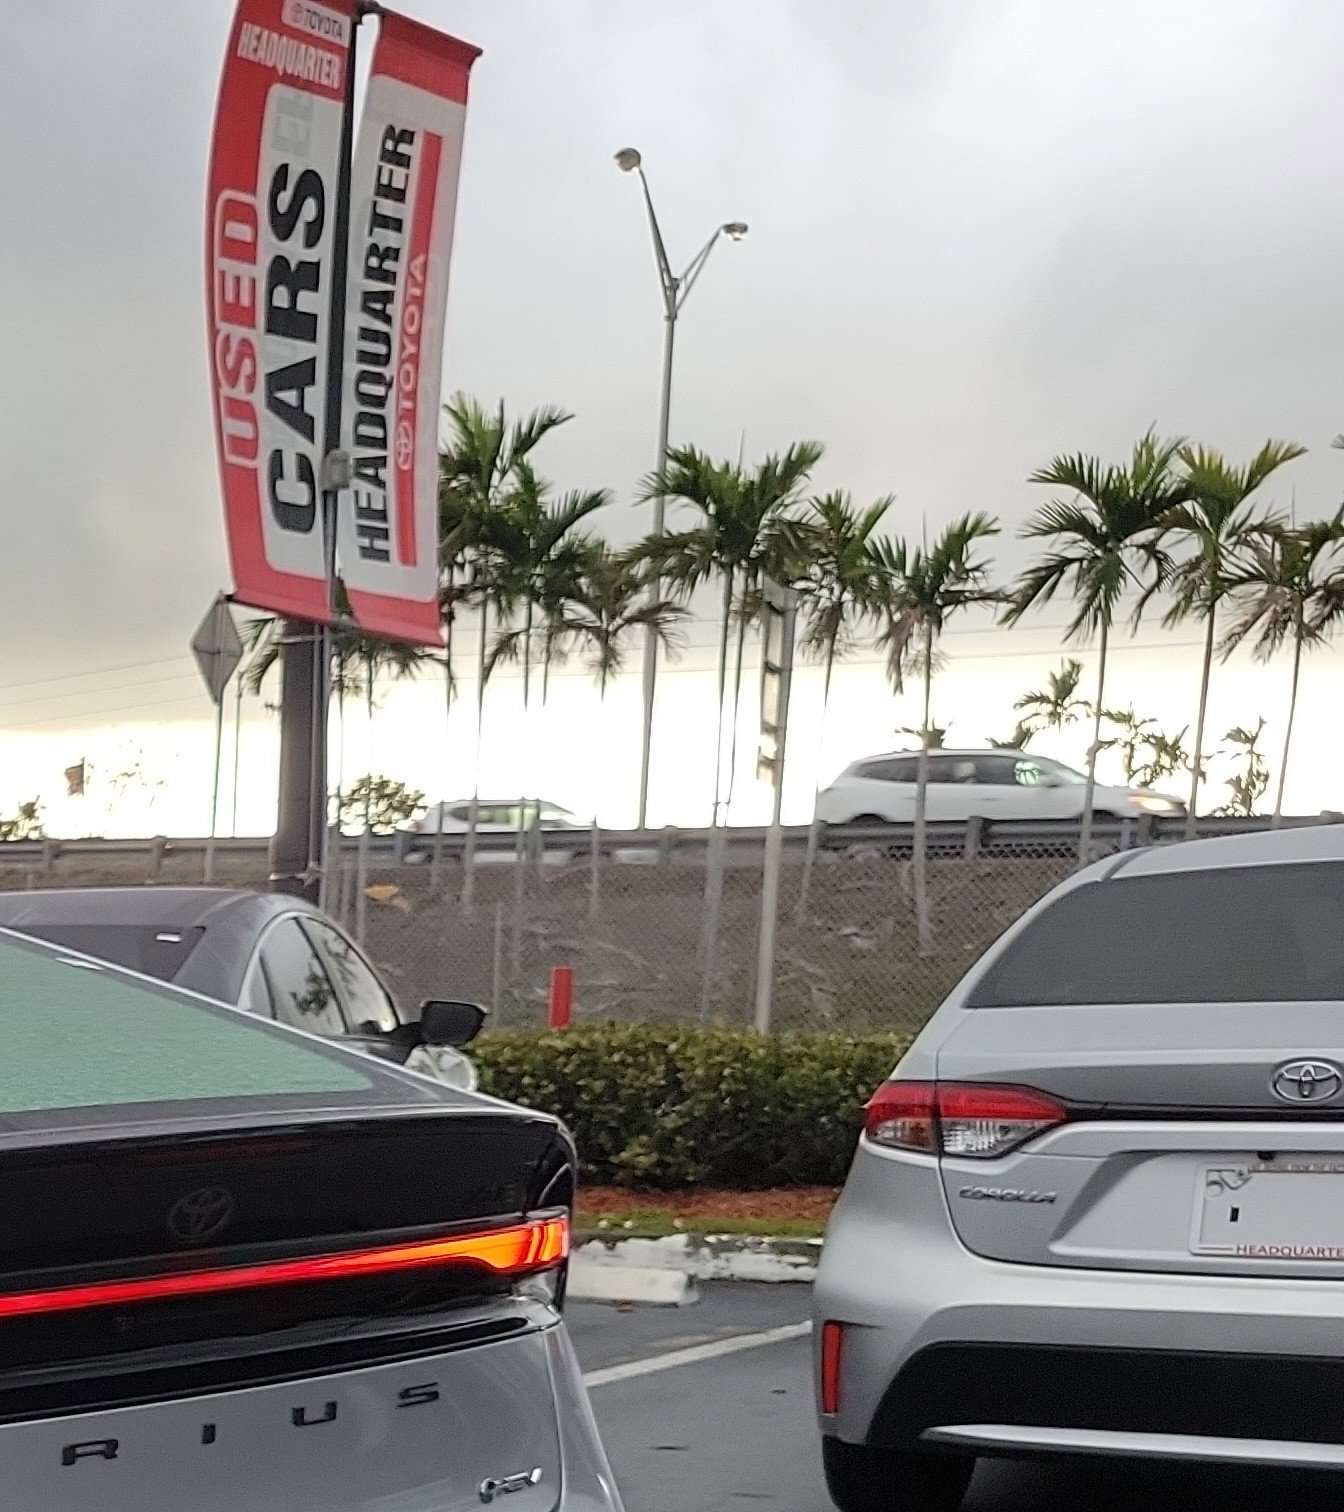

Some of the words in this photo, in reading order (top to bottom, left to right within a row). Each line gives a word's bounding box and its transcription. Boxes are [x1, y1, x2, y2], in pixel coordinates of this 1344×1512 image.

[237, 21, 341, 89] HEADQUARTER
[305, 8, 343, 39] TOYOTA
[216, 195, 259, 460] USED
[265, 163, 325, 534] CARS
[353, 123, 416, 563] HEADQUARTER
[397, 252, 427, 411] TOYOTA
